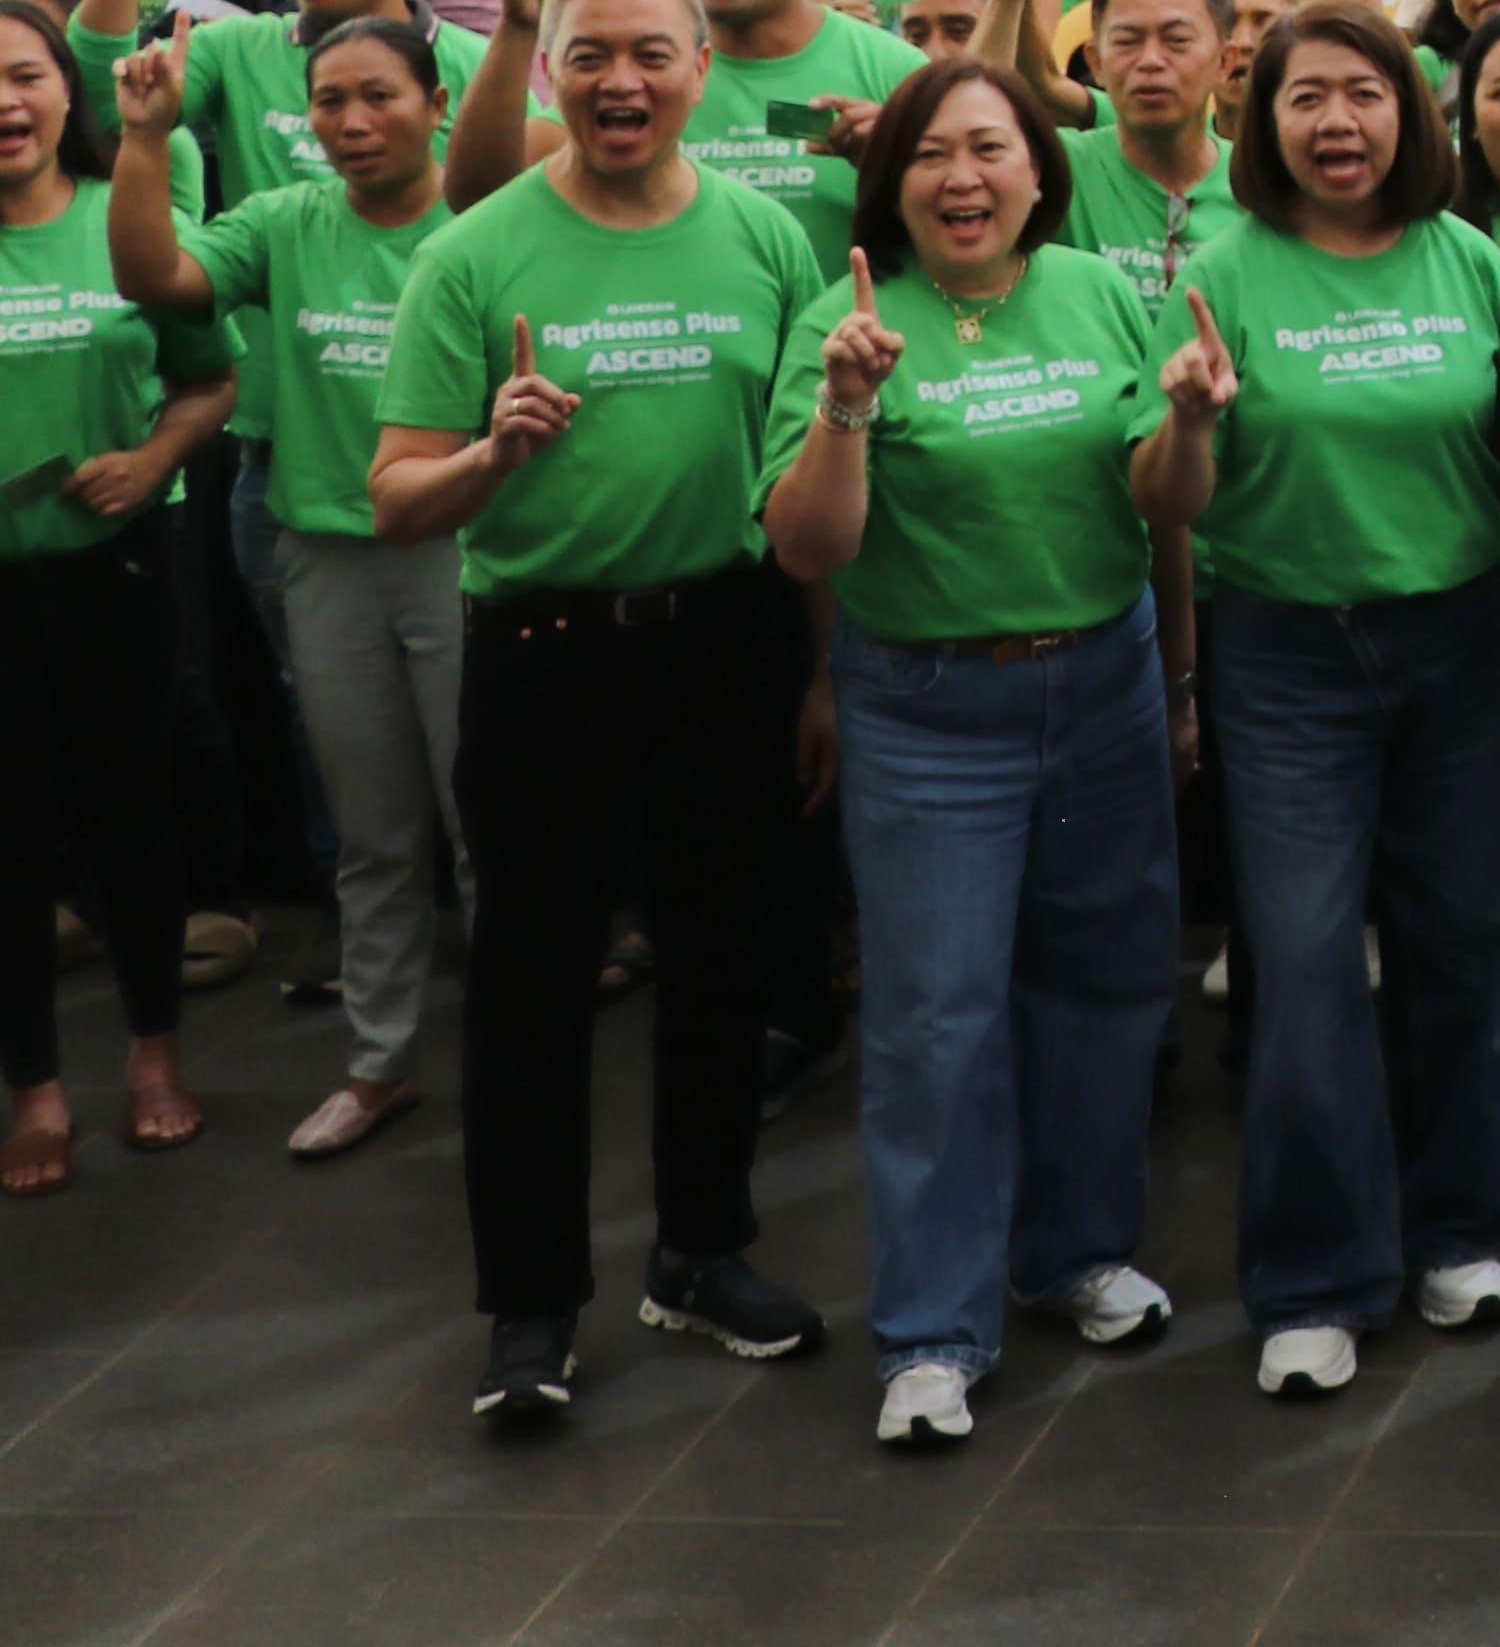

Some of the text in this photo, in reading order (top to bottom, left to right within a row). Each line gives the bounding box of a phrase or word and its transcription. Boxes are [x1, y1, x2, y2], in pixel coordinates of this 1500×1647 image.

[678, 139, 790, 160] grisenso
[722, 166, 817, 188] SCEND
[69, 291, 127, 311] Plus
[542, 311, 742, 350] Agrisenso Plus
[1274, 314, 1467, 352] Agrisenso Plus
[586, 344, 712, 375] ASCEND
[1319, 343, 1444, 373] ASCEND
[917, 359, 1100, 403] Agrisenso Plus
[963, 387, 1080, 426] ASCEND
